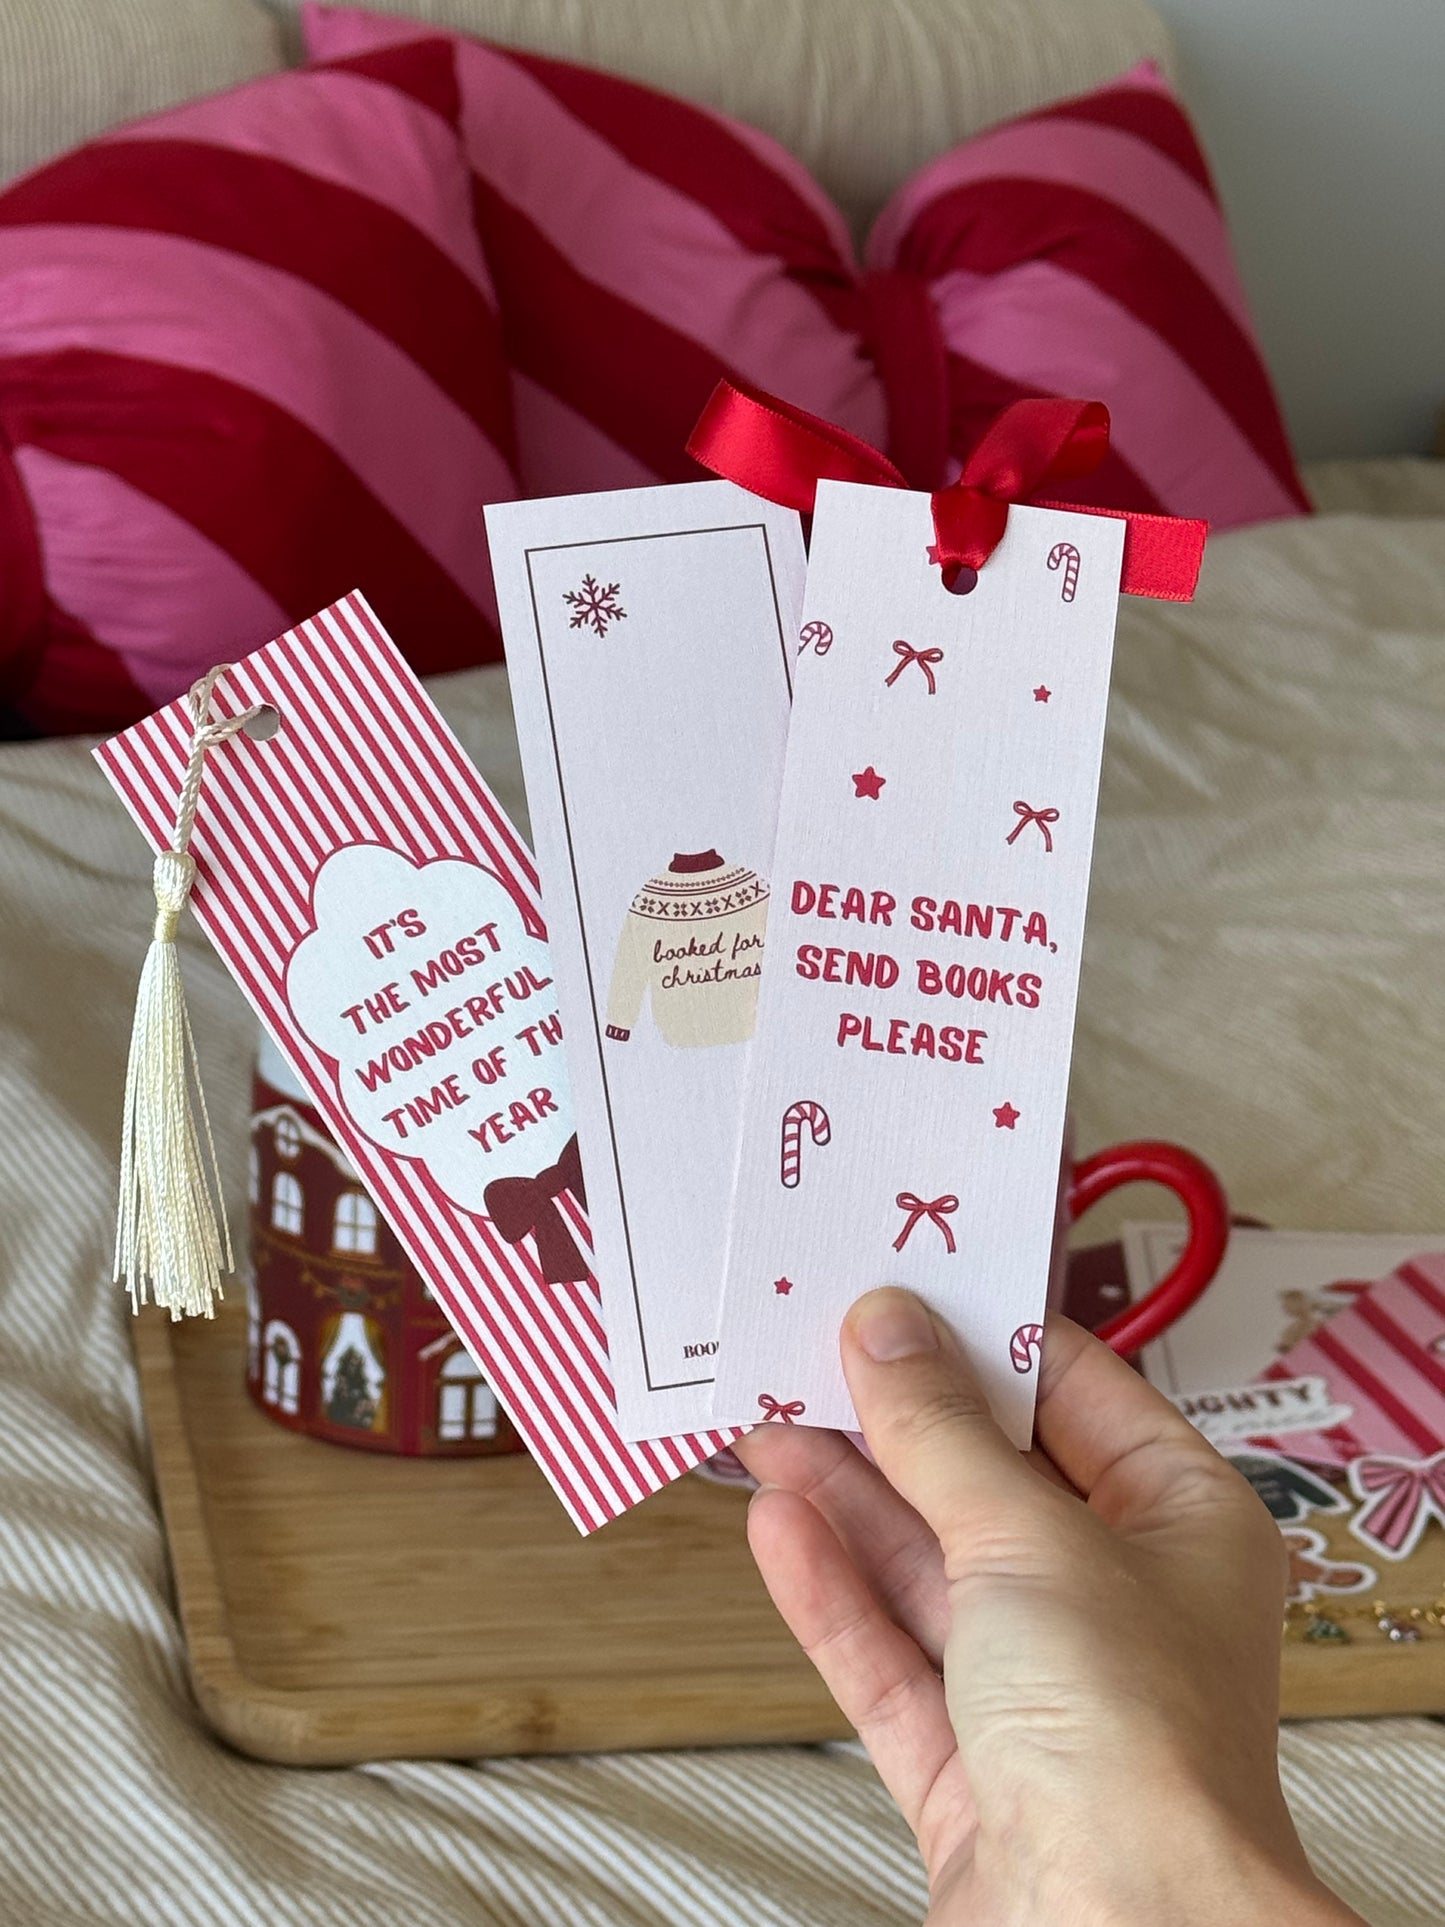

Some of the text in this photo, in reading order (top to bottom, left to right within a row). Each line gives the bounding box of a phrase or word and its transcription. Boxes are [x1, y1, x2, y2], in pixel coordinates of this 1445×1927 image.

[362, 908, 427, 960] IT'S
[653, 931, 765, 963] booked for
[791, 880, 1058, 953] DEAR SANTA,
[340, 922, 501, 1035] THE MOST
[662, 959, 762, 989] christmas
[796, 944, 1043, 1008] SEND BOOKS
[355, 966, 553, 1092] WONDERFUL
[837, 1013, 988, 1064] PLEASE
[382, 1009, 564, 1138] TIME OF TH
[467, 1087, 559, 1153] YEAR
[682, 1341, 719, 1359] BOO
